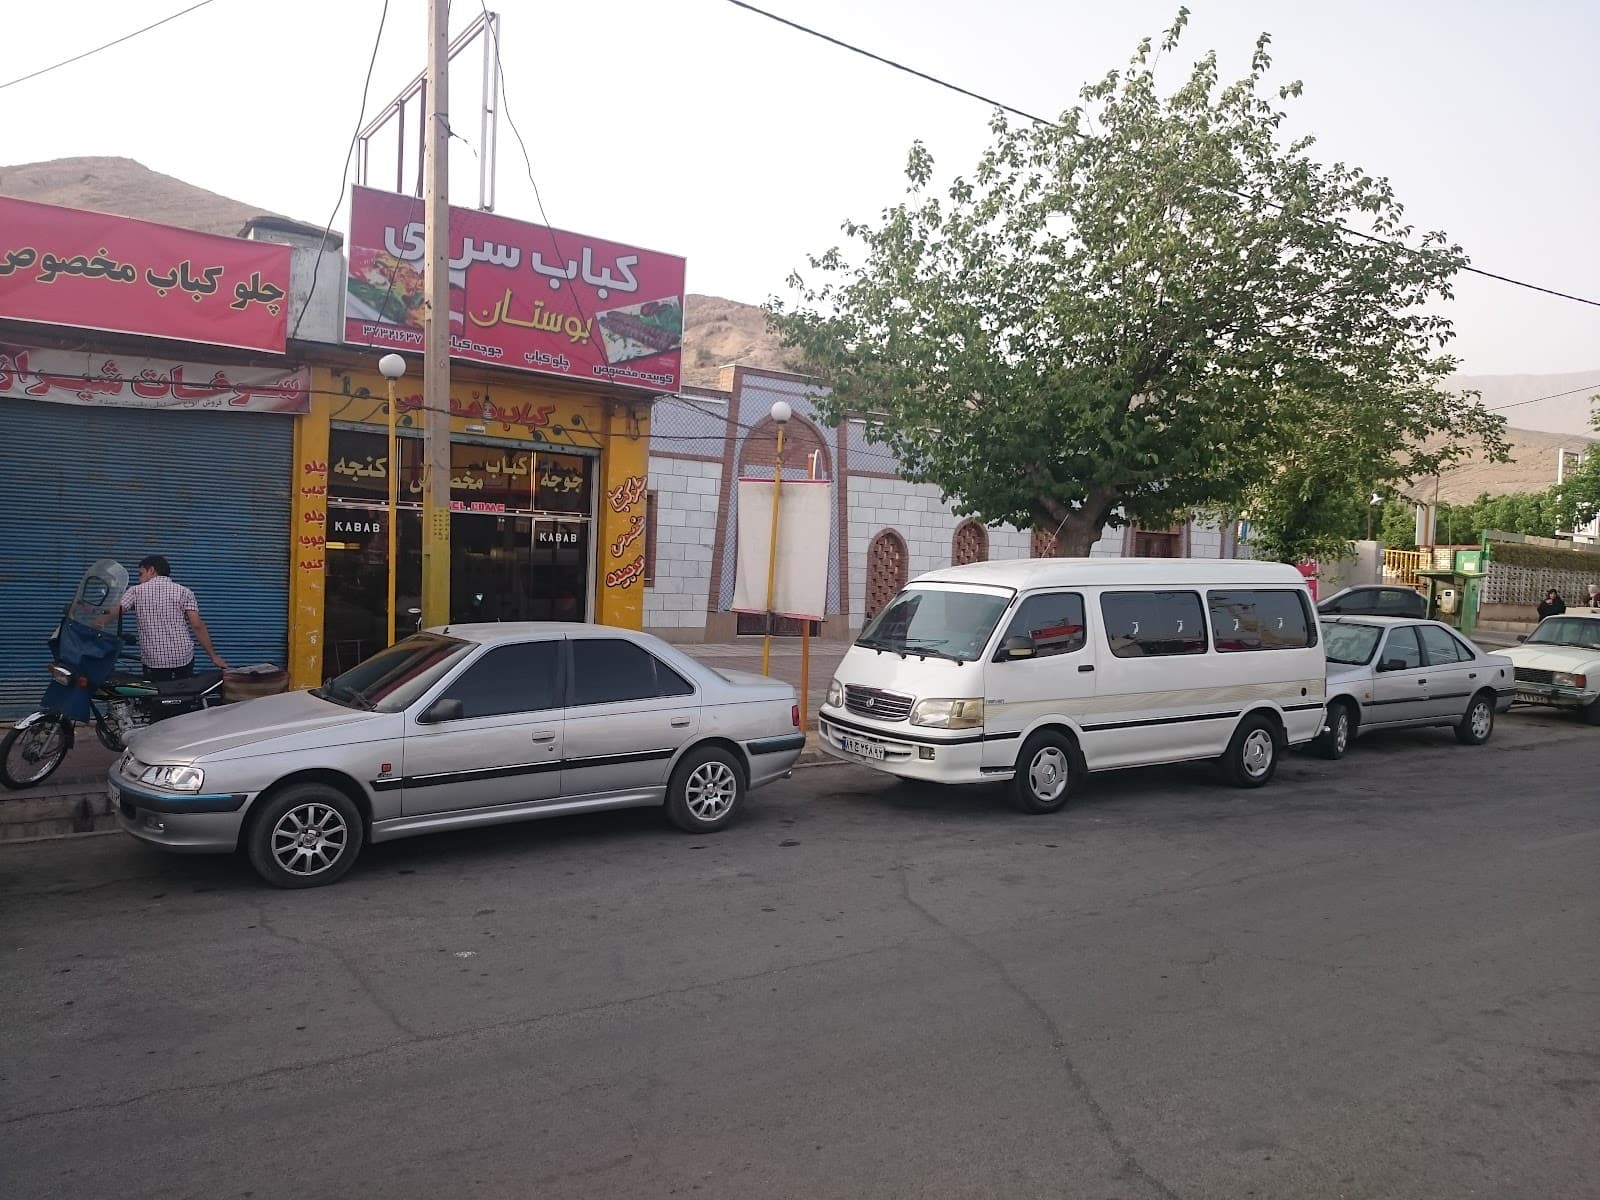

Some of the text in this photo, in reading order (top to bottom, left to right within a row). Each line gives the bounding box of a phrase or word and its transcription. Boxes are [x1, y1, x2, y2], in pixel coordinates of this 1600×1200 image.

[0, 247, 286, 316] چلو کباب مخصوص
[530, 246, 639, 300] کباب
[469, 288, 594, 346] بوستان
[449, 335, 503, 358] جوجه کبا
[524, 350, 571, 373] چلو کباب
[131, 364, 303, 407] سوغات
[593, 365, 674, 384] کوبیده مخصوص
[497, 402, 556, 433] کباب
[304, 460, 327, 480] چلو
[333, 456, 387, 482] کنجه
[485, 456, 529, 480] کباب
[301, 485, 326, 498] کباب
[540, 472, 584, 493] جوجه
[450, 501, 505, 512] EL COME
[304, 510, 326, 529] چلو
[334, 521, 380, 533] KABAB
[539, 532, 577, 543] KABAB
[606, 555, 644, 588] کوبیده
